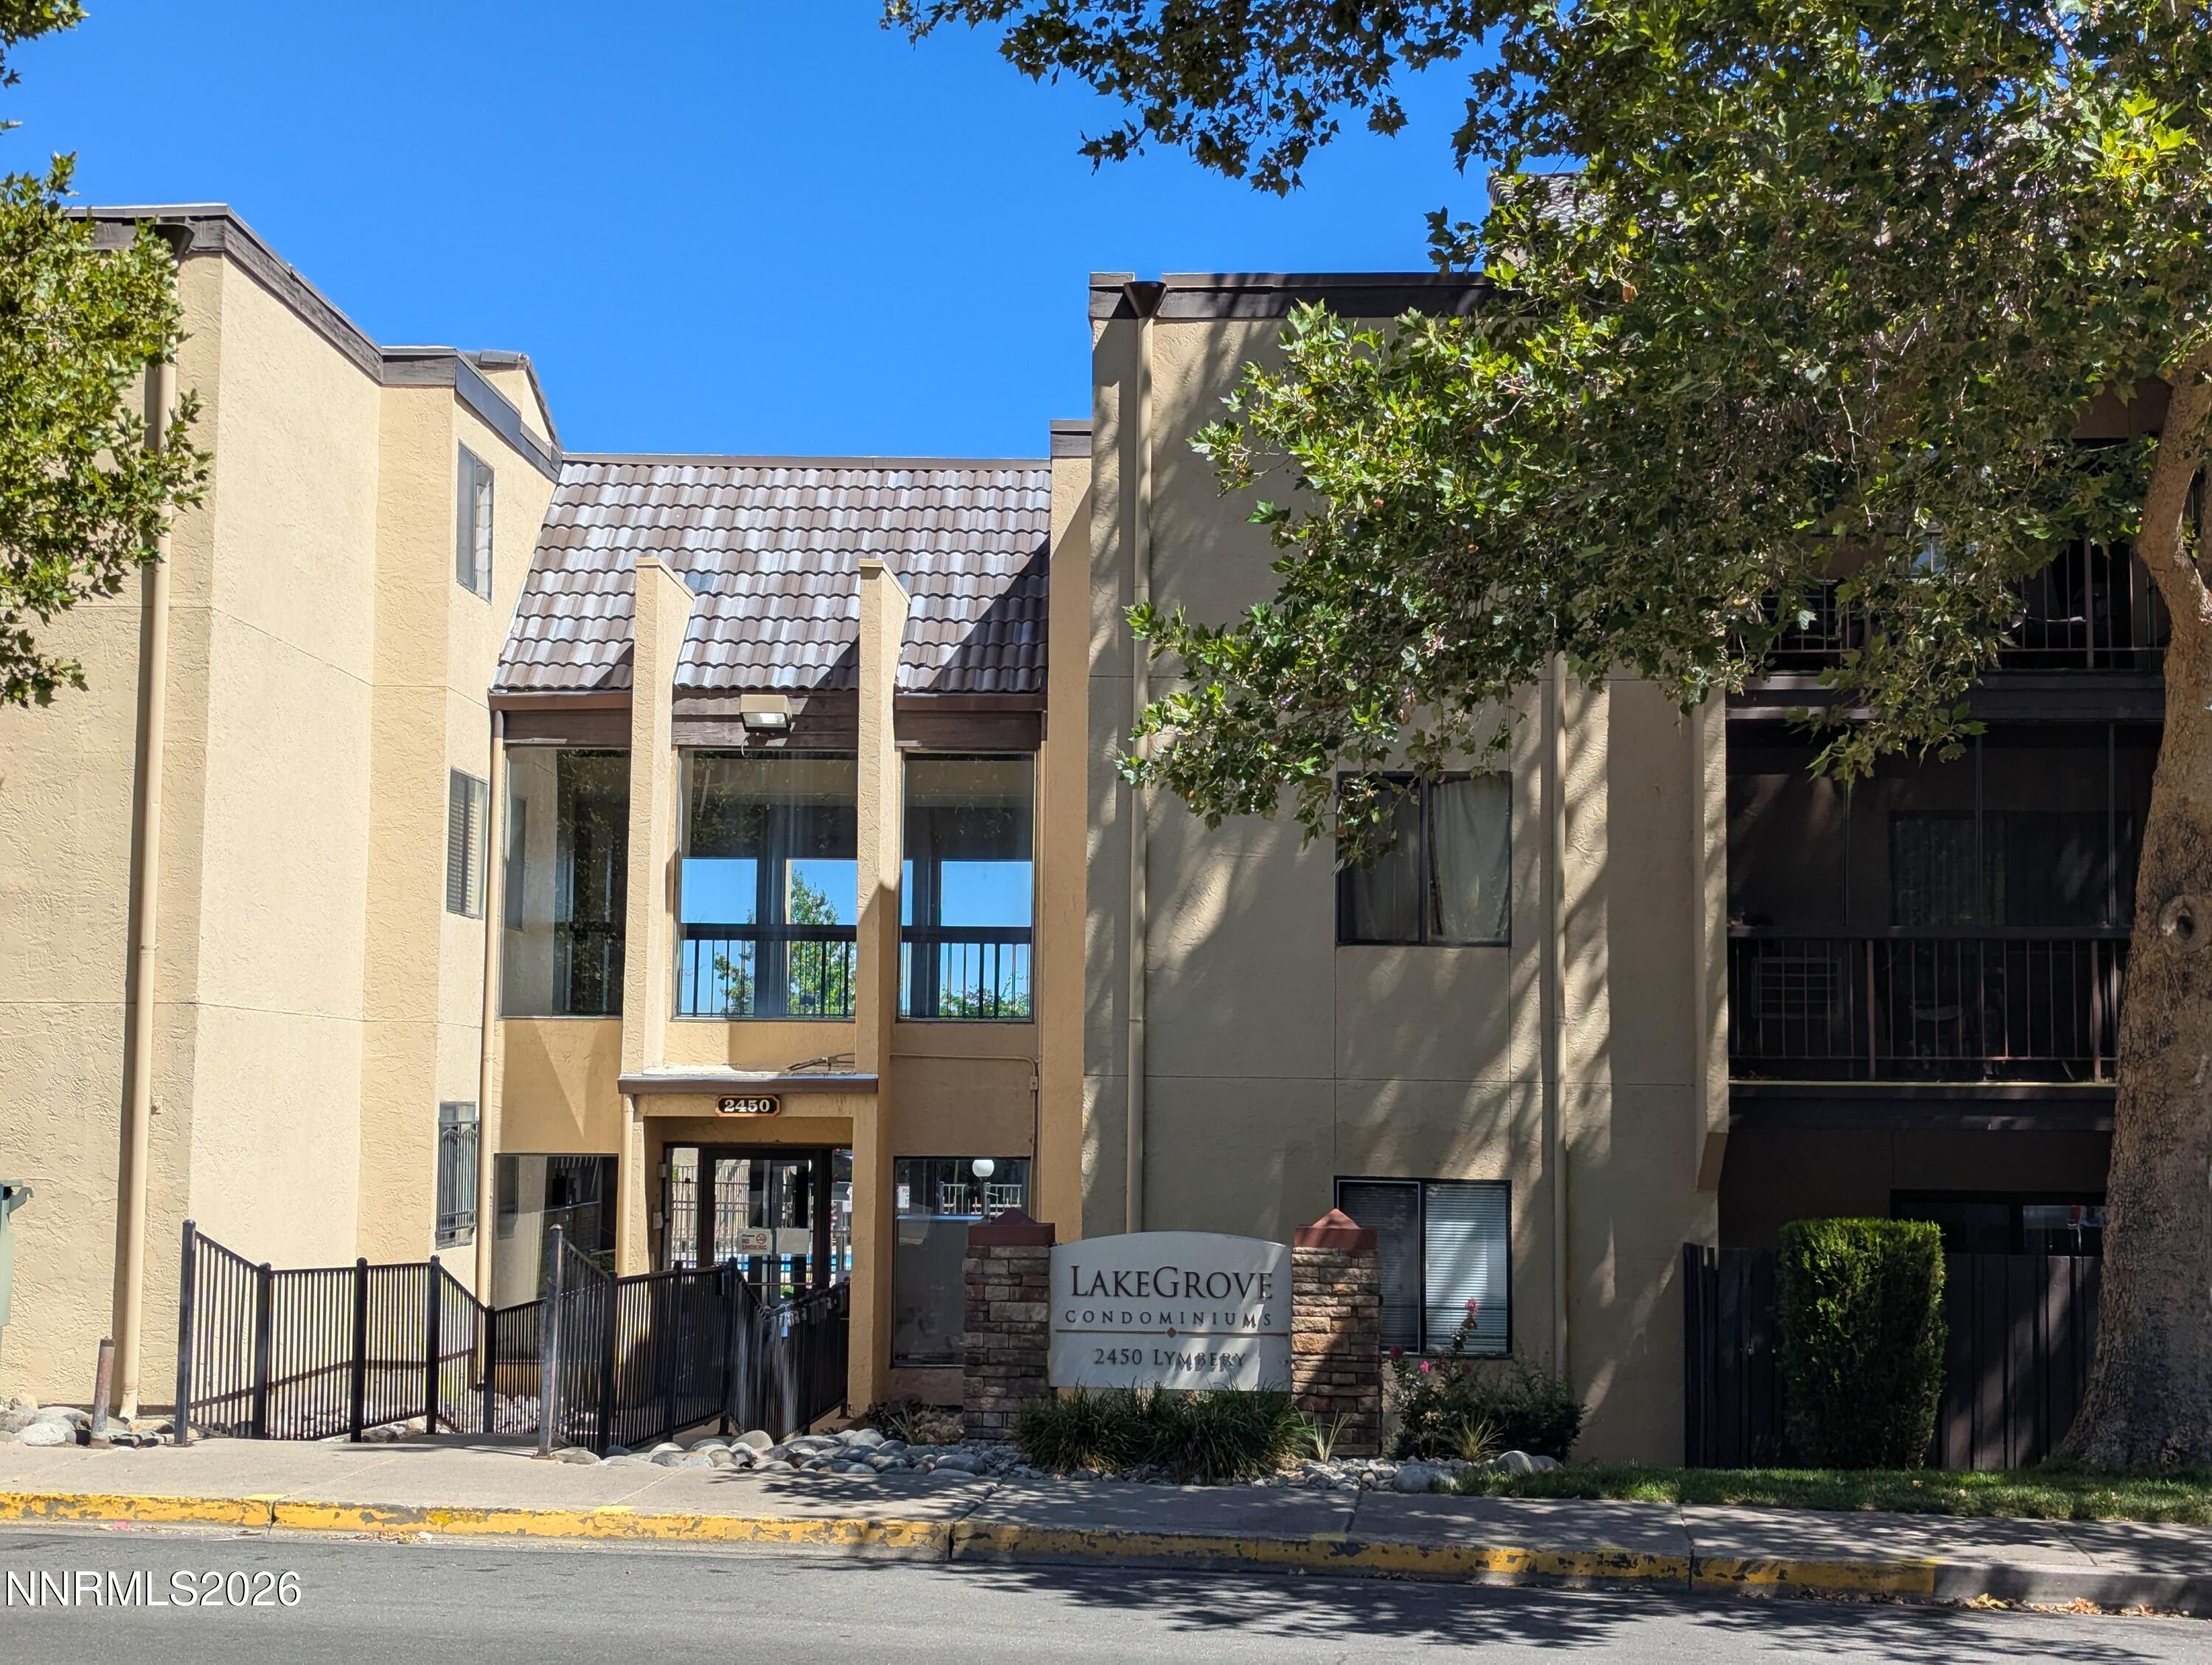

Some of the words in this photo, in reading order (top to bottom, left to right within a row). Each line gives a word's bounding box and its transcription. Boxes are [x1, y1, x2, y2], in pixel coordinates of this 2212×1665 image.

[724, 1099, 771, 1112] 2450
[1071, 1265, 1273, 1301] LAKEGROVE
[1065, 1310, 1271, 1328] CONDOMINIUMS
[1094, 1348, 1143, 1365] 2450
